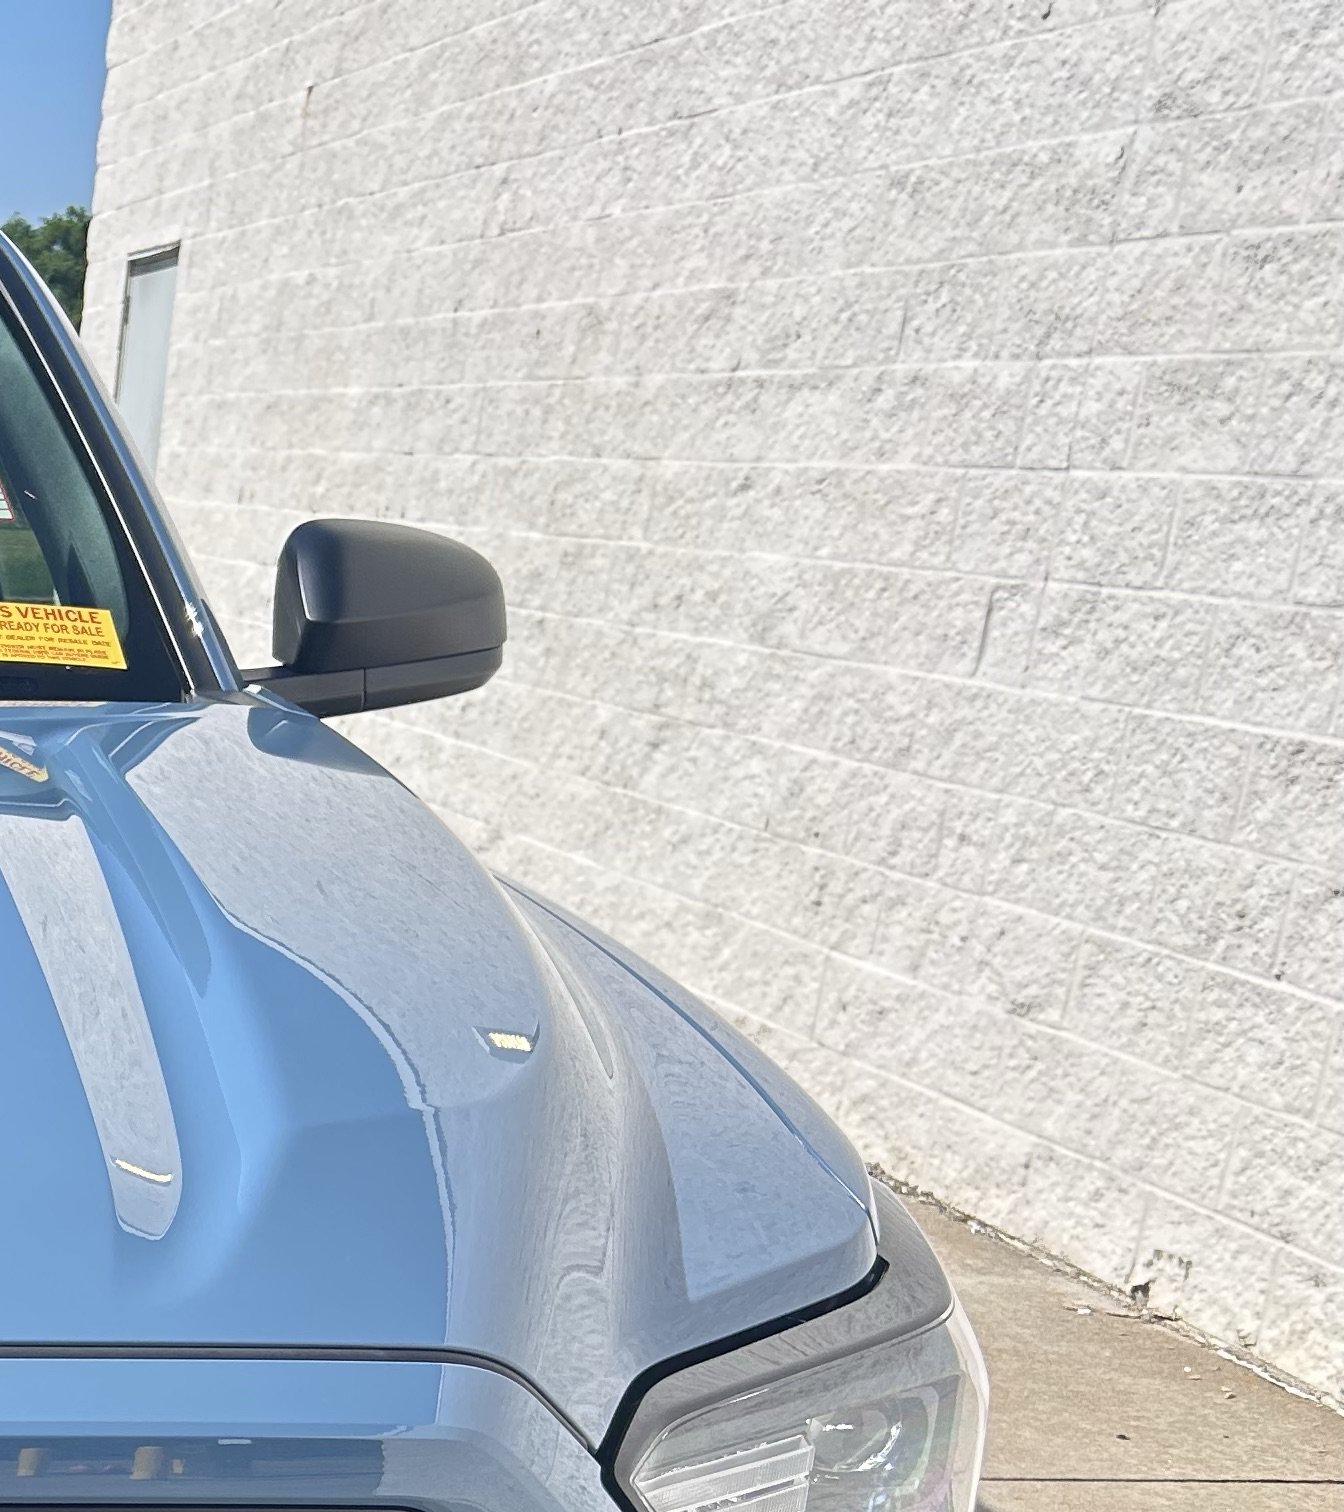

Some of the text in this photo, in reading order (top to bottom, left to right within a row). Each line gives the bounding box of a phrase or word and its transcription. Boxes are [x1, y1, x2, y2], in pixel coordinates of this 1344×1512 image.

[14, 606, 102, 624] VEHICLE
[0, 620, 40, 633] READY
[43, 622, 70, 635] FOR
[73, 624, 105, 637] SALE
